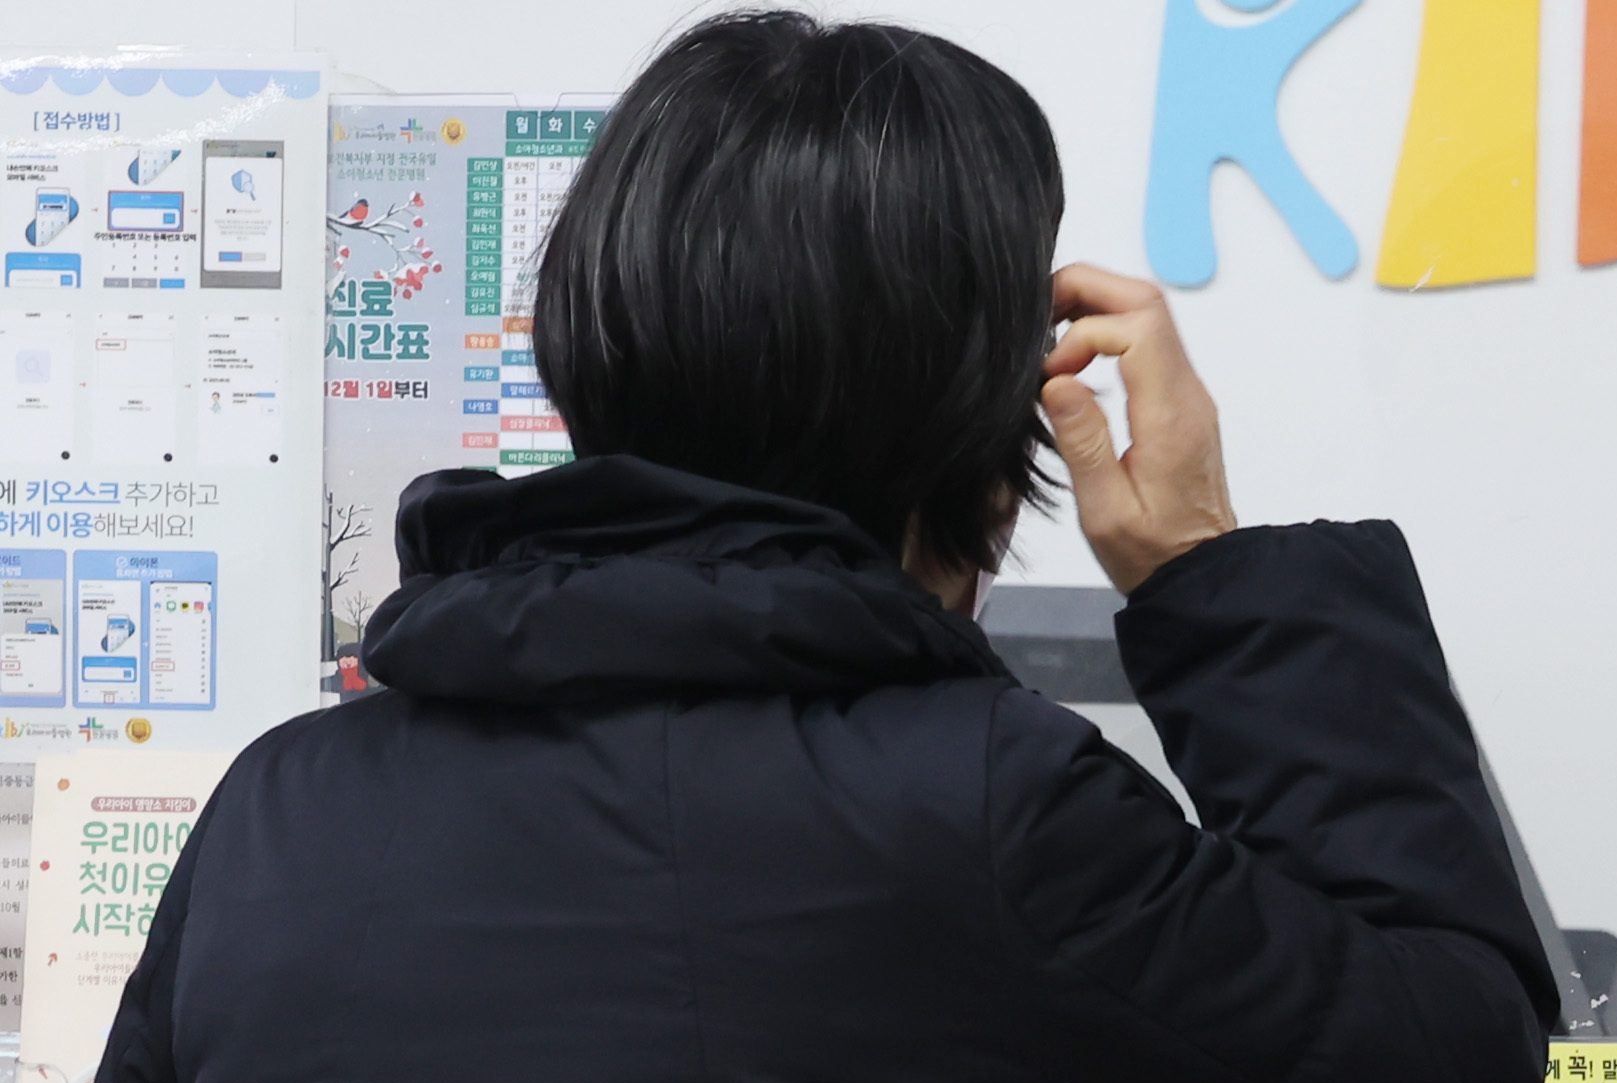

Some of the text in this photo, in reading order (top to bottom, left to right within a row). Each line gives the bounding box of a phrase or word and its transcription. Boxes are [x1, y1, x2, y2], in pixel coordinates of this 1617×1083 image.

[43, 112, 110, 131] 접수방법
[515, 117, 596, 133] 월 화 수
[325, 323, 430, 360] 시간표
[366, 381, 428, 399] 1일부터
[26, 481, 219, 506] 키오스크 추가하고
[46, 512, 195, 539] 이용해보세요!
[1568, 1055, 1593, 1080] 꼭!
